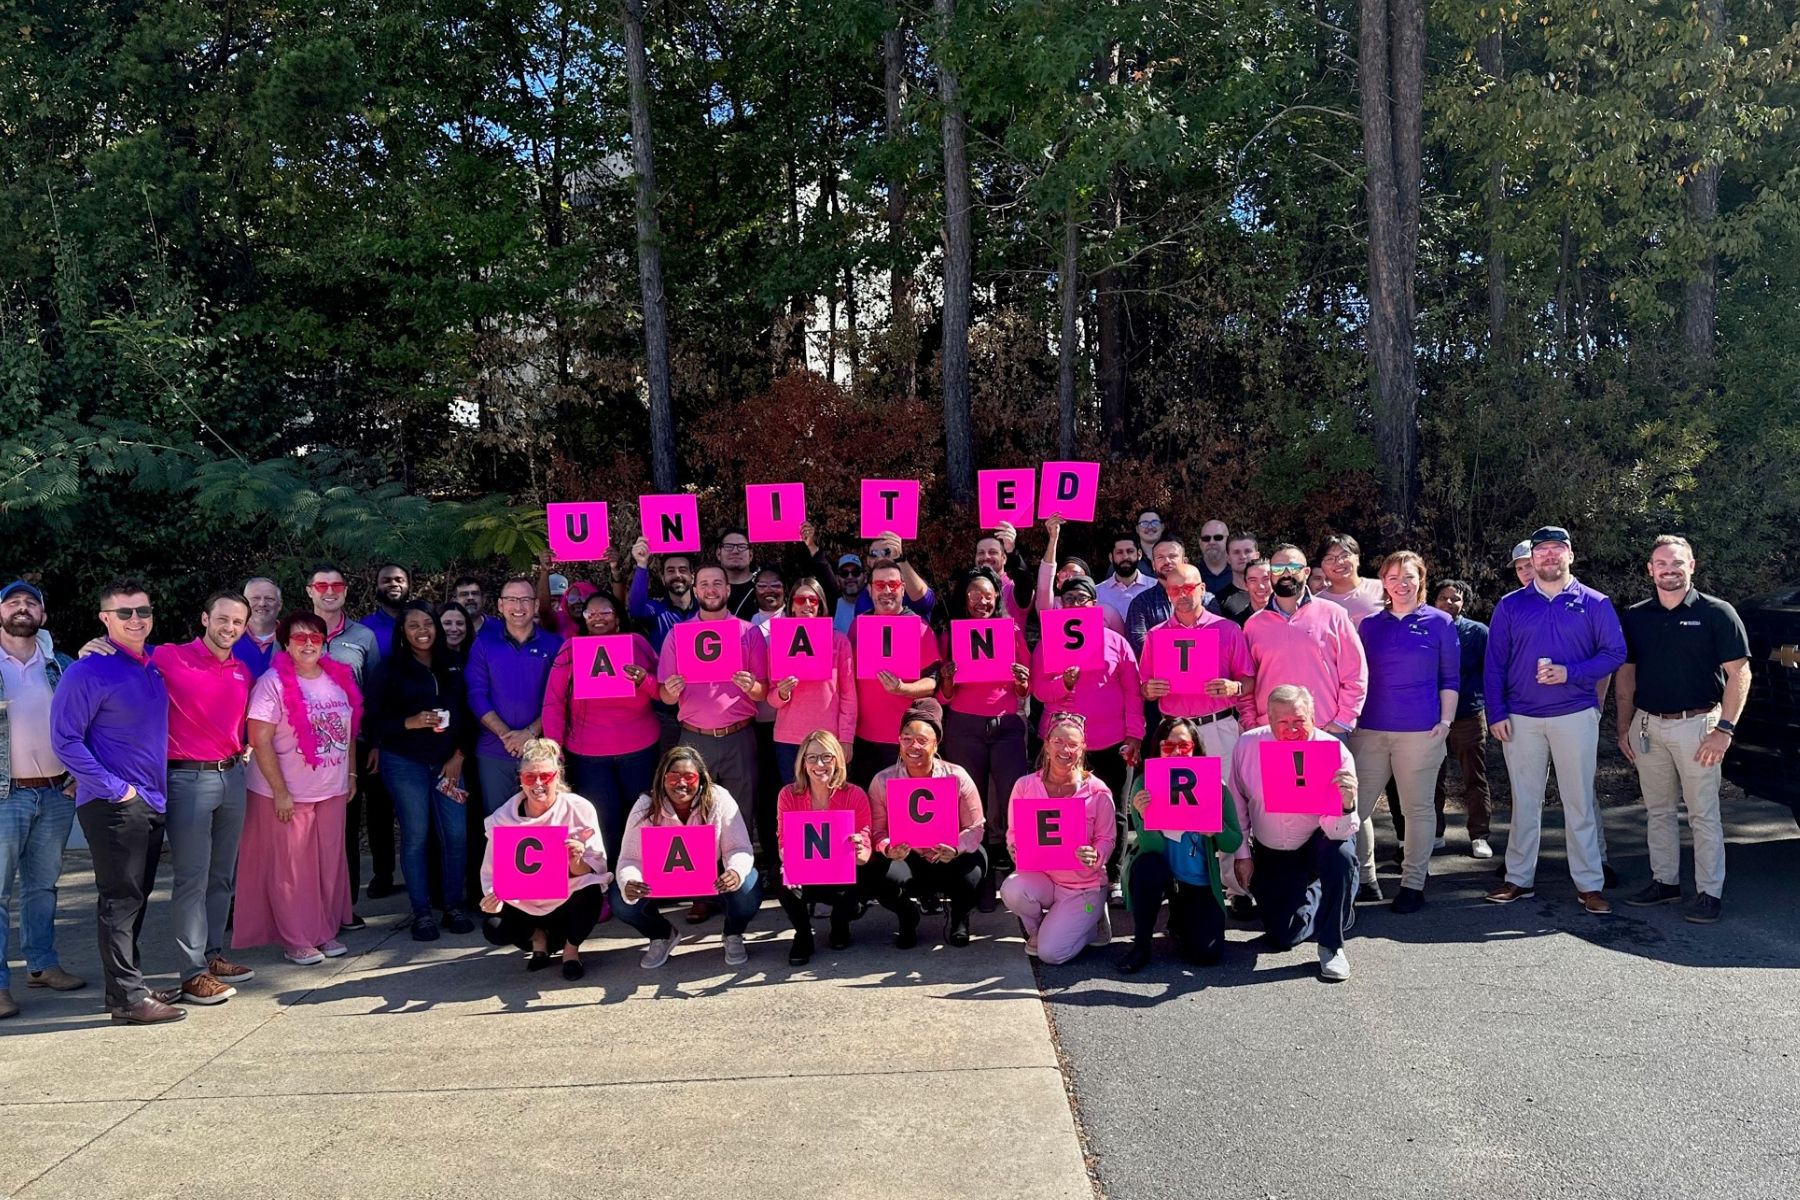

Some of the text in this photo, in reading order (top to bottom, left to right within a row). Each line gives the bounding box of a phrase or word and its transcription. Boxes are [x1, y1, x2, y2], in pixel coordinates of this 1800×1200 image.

[996, 480, 1017, 511] E
[1056, 471, 1080, 501] D
[771, 491, 781, 521] I
[879, 490, 900, 521] T
[565, 513, 589, 543] U
[660, 513, 684, 543] N
[694, 630, 722, 662] G
[788, 625, 814, 657] A
[882, 626, 892, 658] I
[969, 627, 995, 661] N
[1063, 618, 1085, 651] S
[590, 646, 616, 678] A
[1173, 639, 1196, 672] T
[1292, 750, 1304, 787] !
[1169, 767, 1199, 806] R
[908, 788, 935, 824] C
[804, 822, 831, 860] N
[1036, 809, 1062, 846] E
[515, 837, 543, 875] C
[663, 836, 695, 873] A
